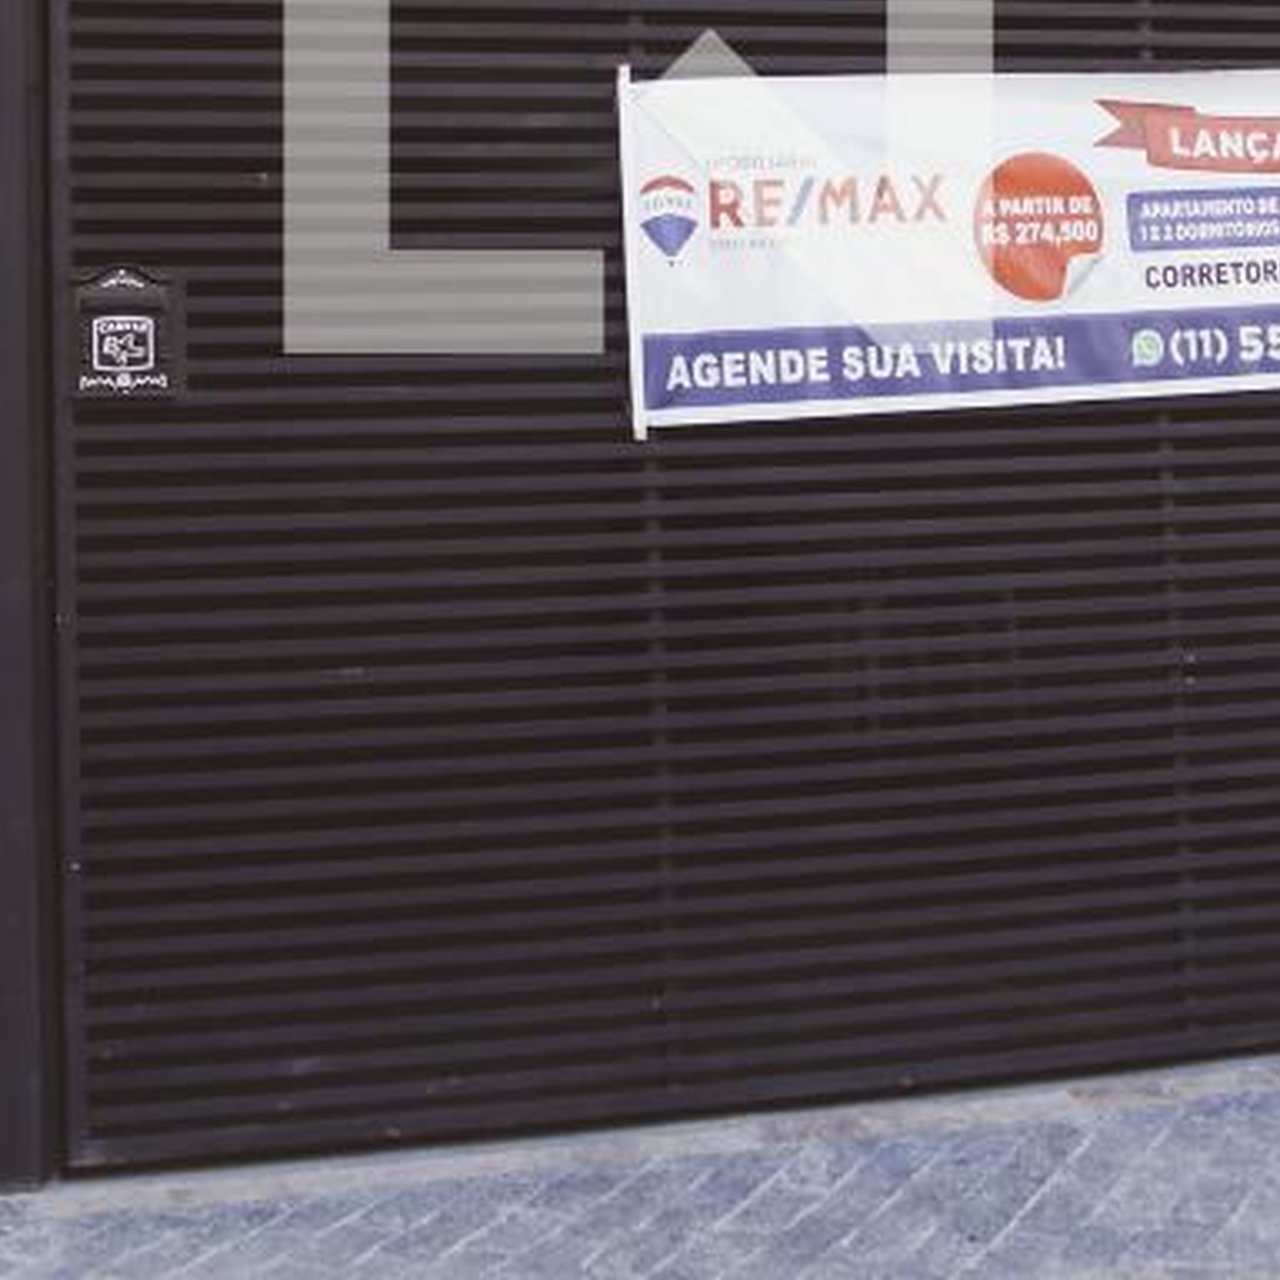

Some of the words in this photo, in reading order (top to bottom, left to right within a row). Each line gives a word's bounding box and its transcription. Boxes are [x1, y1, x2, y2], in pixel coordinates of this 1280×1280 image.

[708, 173, 947, 228] RE/MAX
[667, 348, 829, 391] AGENDE
[843, 345, 921, 378] SUA
[931, 336, 1065, 376] VISITA!
[1169, 327, 1228, 365] (11)
